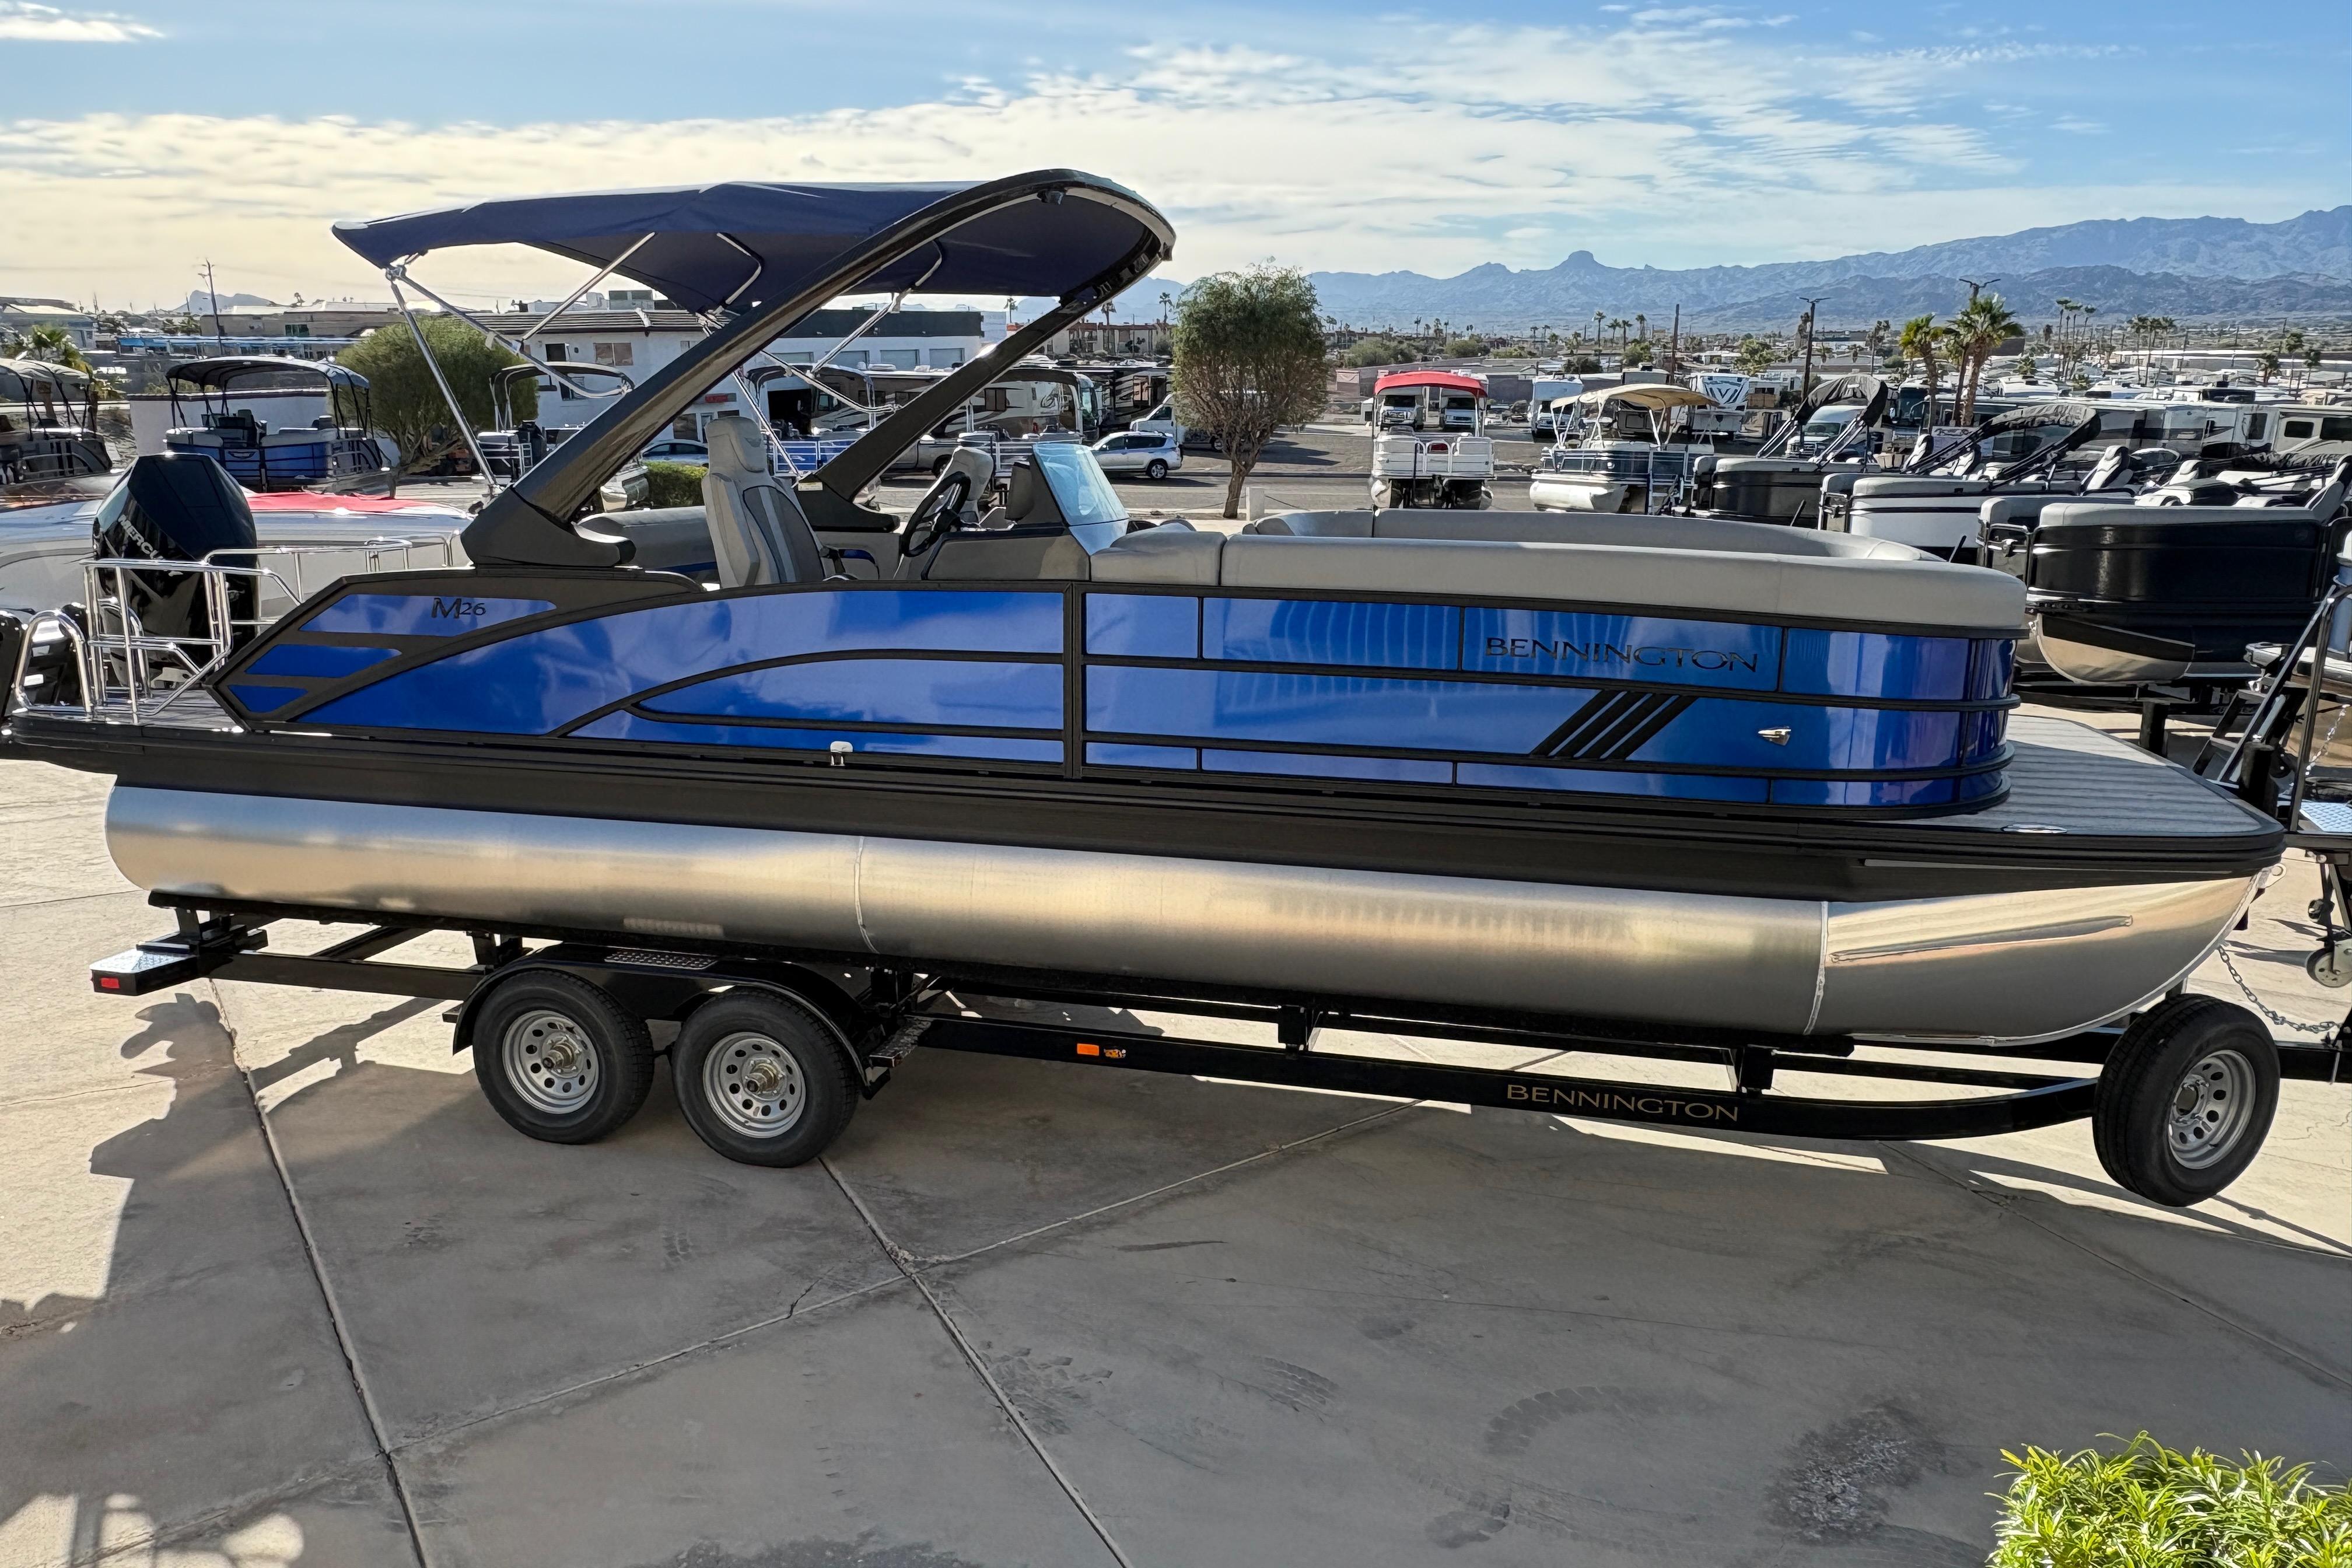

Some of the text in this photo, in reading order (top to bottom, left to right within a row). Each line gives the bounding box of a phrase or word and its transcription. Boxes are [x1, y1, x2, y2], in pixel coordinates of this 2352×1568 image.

[431, 597, 487, 619] M26
[1485, 636, 1758, 673] BENNINGTON
[1507, 1084, 1738, 1122] BENNINGTON
